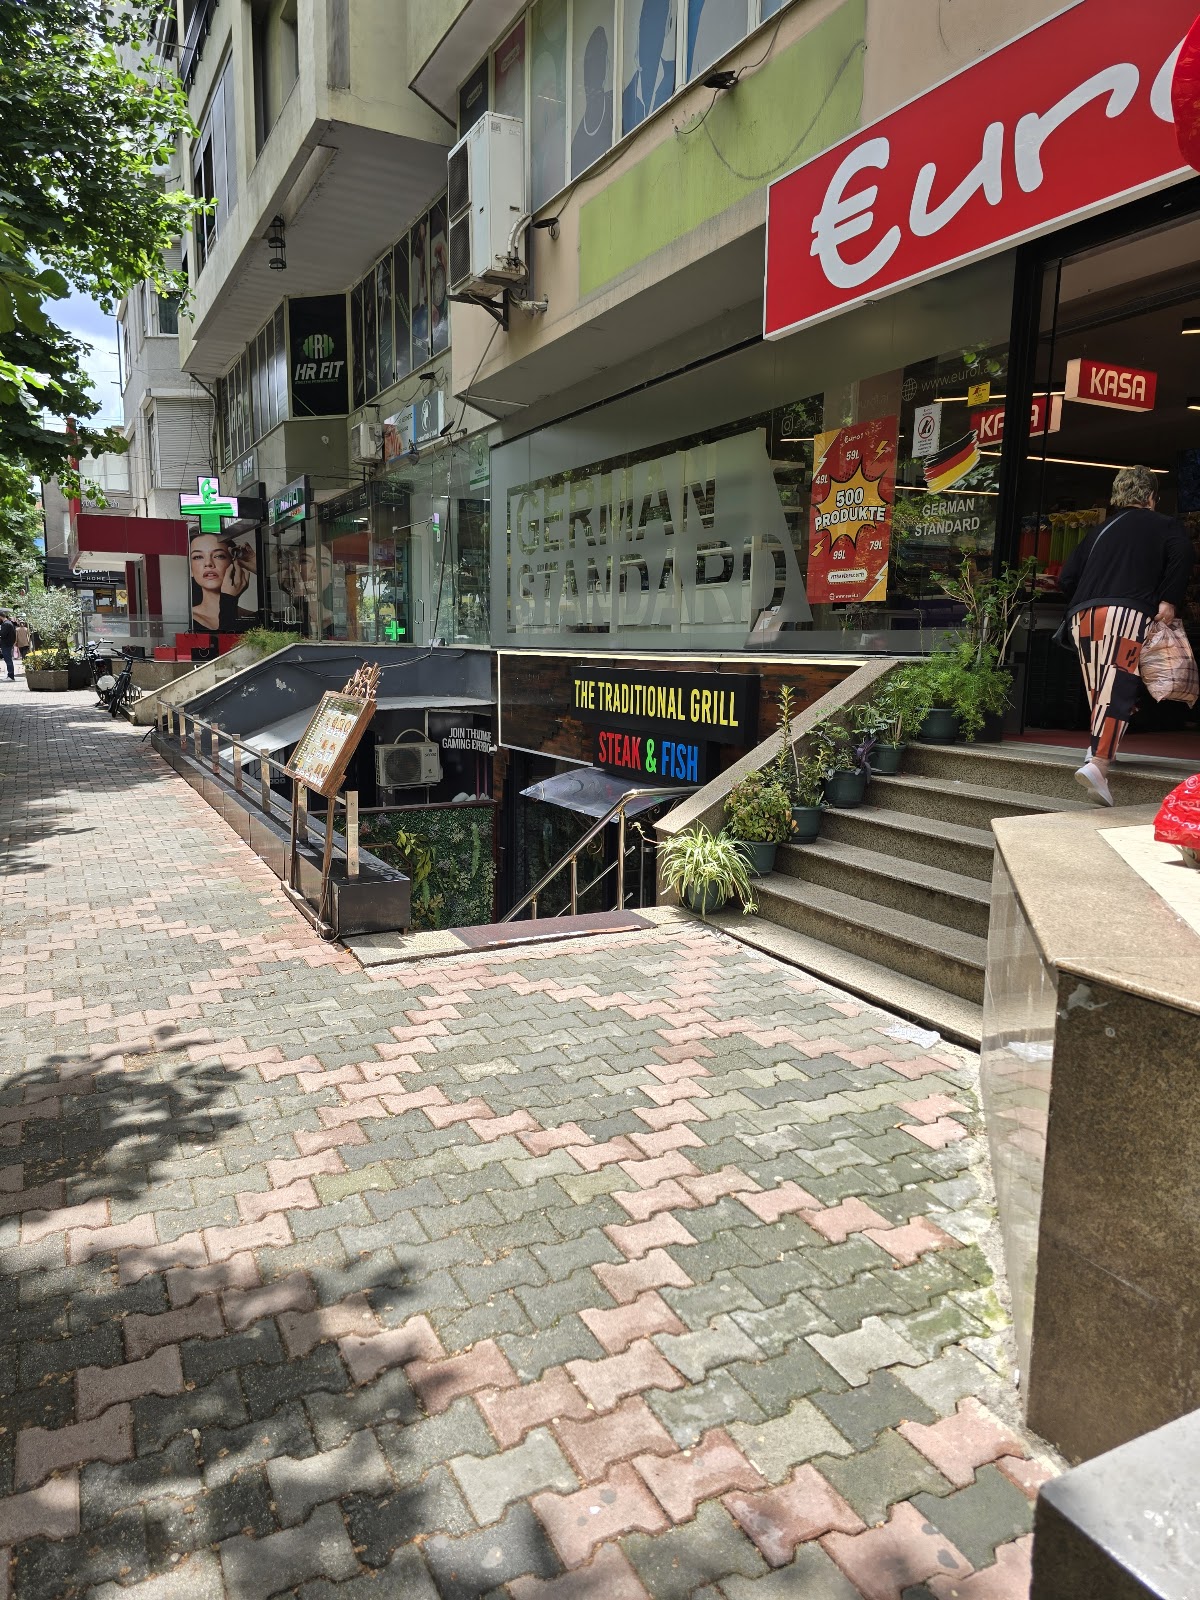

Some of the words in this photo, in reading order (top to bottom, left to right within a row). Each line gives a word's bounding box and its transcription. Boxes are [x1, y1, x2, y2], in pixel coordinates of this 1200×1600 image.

[294, 362, 317, 381] HR
[319, 360, 345, 379] FIT
[1089, 366, 1146, 402] KASA
[979, 404, 1039, 439] KAA
[845, 449, 860, 461] 59L
[814, 474, 829, 485] 49L
[516, 445, 716, 556] GERMAN
[835, 486, 865, 509] 500
[922, 497, 975, 517] GERMAN
[814, 505, 887, 531] PRODUKTE
[914, 516, 981, 537] STANDARD
[832, 549, 846, 560] 99L
[869, 540, 883, 551] 79L
[515, 534, 787, 626] STANDARD
[574, 679, 595, 710] THE
[597, 681, 686, 721] TRADITIONAL
[690, 688, 739, 727] GRILL
[441, 737, 471, 750] GAMING
[448, 727, 465, 739] JOIN
[598, 731, 642, 771] STEAK
[645, 738, 657, 774] &
[661, 740, 699, 783] FISH
